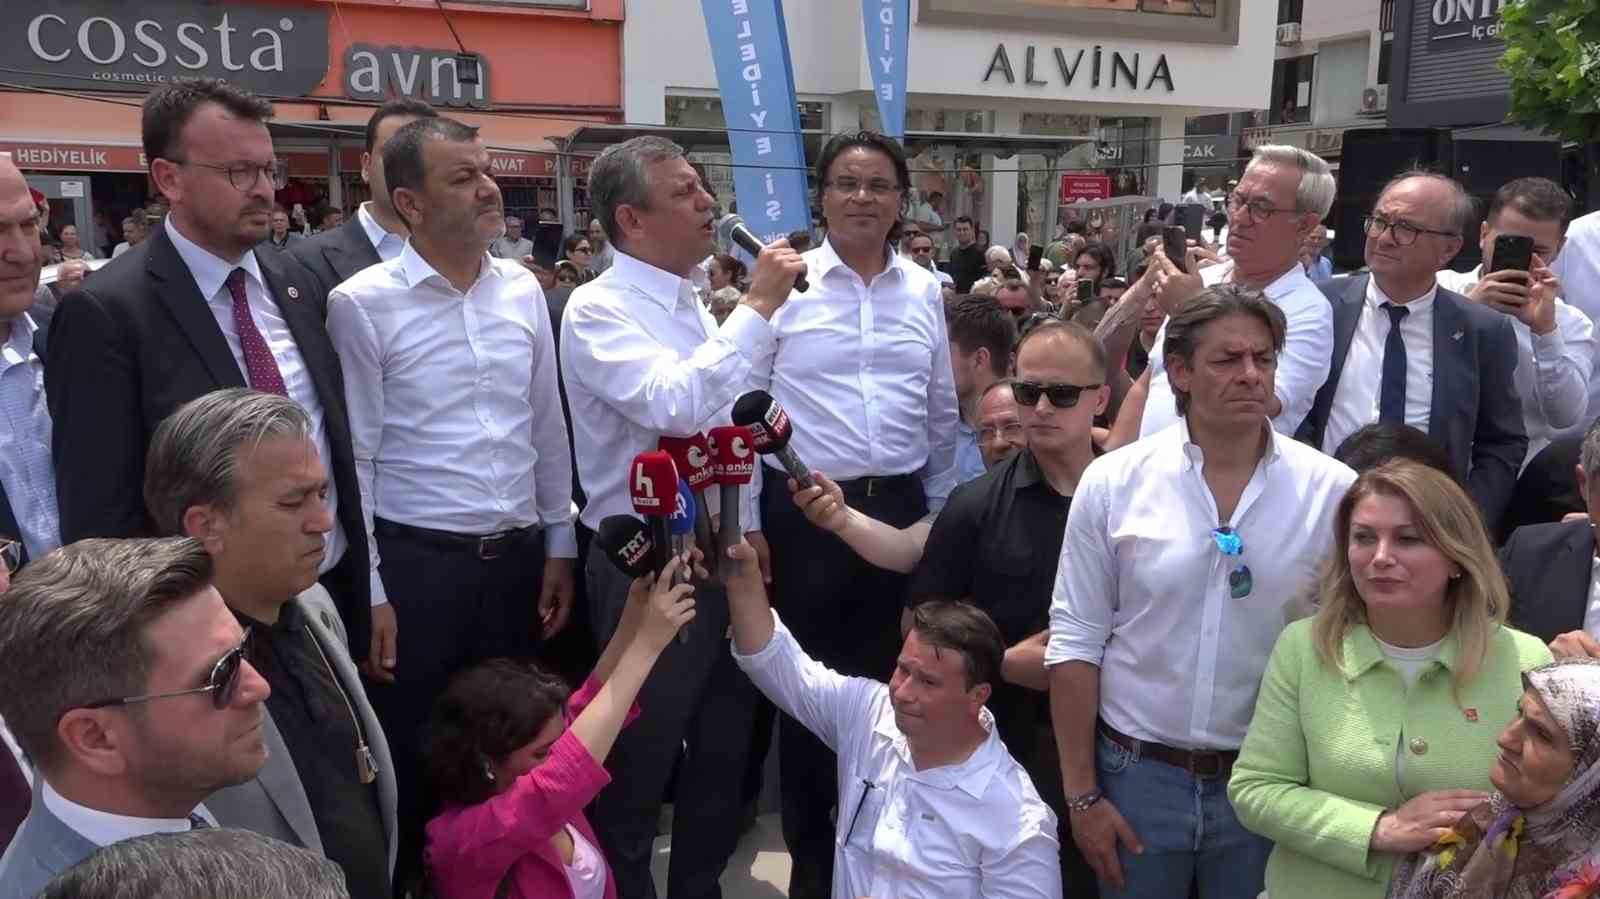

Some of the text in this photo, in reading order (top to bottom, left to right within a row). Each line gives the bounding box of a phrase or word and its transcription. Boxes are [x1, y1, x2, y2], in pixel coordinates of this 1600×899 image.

[350, 51, 484, 100] avm
[983, 43, 1175, 92] ALVİNA
[92, 71, 167, 83] cosmetic
[17, 148, 107, 166] HEDİYELİK
[1183, 144, 1215, 158] CAK
[490, 158, 525, 172] AVAT
[618, 531, 645, 559] TRT
